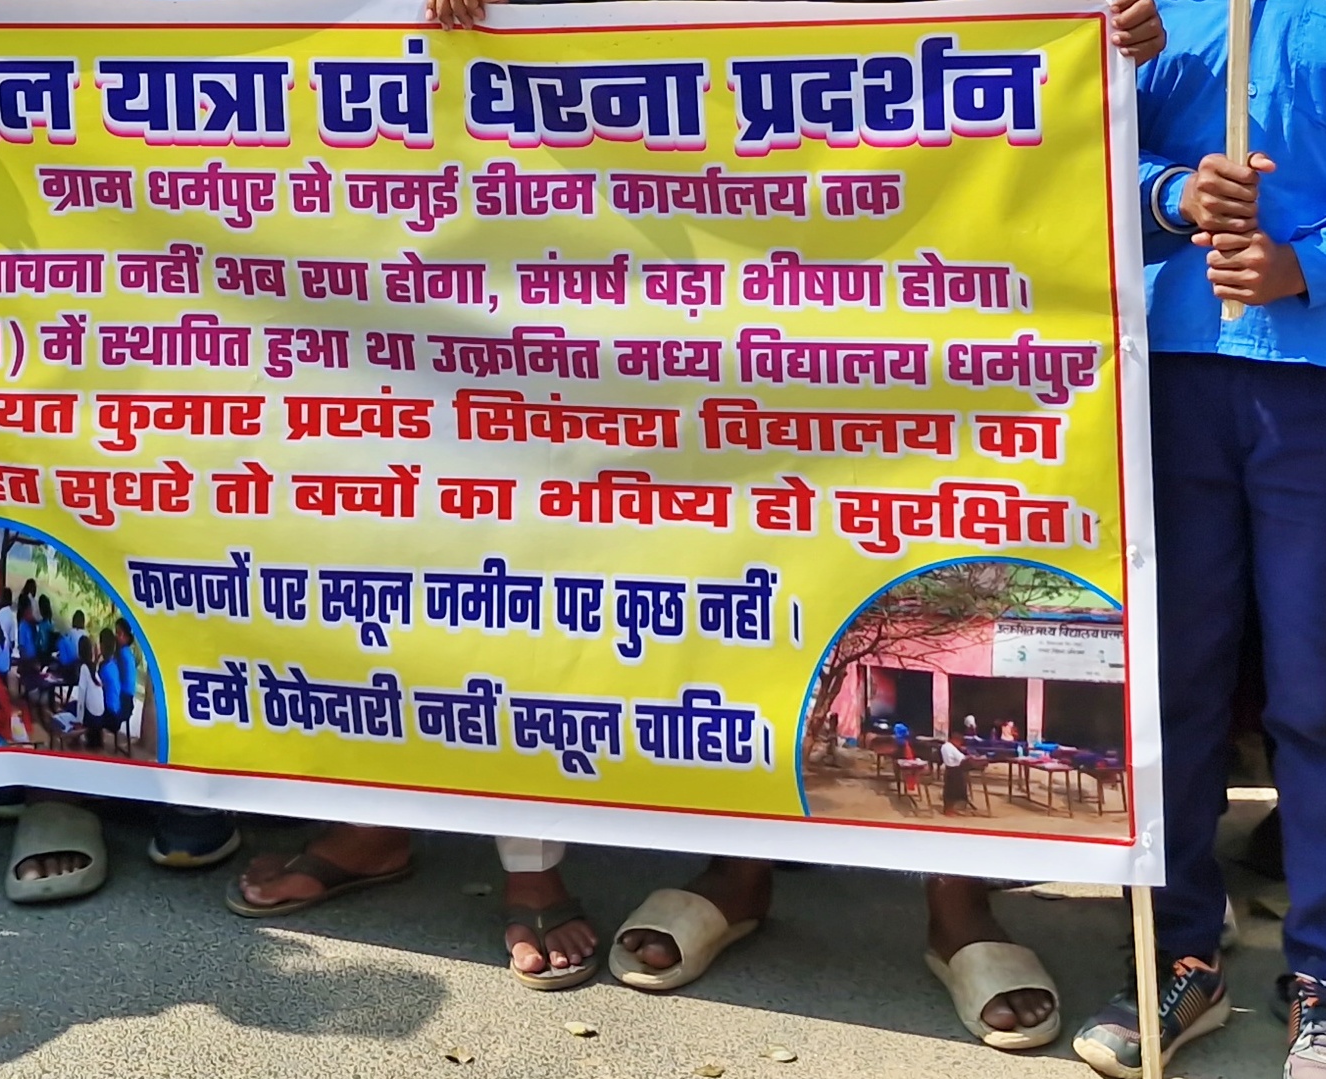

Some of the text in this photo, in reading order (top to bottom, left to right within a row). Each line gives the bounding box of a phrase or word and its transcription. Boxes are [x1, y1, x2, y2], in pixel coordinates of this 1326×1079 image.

[97, 60, 291, 141] यात्रा
[313, 39, 437, 142] एवं
[468, 56, 707, 144] धरना
[731, 36, 1044, 150] प्रदर्शन
[39, 162, 904, 231] ग्राम धर्मपुर से जमुई डीएम कार्यालय तक
[118, 245, 204, 295] नहीं
[217, 257, 286, 297] अब
[298, 261, 368, 302] रण
[518, 251, 629, 306] संघर्ष
[643, 264, 725, 317] बड़ा
[742, 251, 881, 306] भीषण
[41, 315, 88, 365] में
[100, 314, 251, 367] स्थापित
[264, 326, 349, 378] हुआ
[366, 332, 415, 371] था
[615, 339, 722, 382] मध्य
[738, 327, 929, 385] विद्यालय
[948, 334, 1099, 403] धर्मपुर
[97, 394, 266, 451] कुमार
[284, 385, 434, 441] प्रखंड
[452, 388, 680, 448] सिकंदरा
[699, 397, 955, 455] विद्यालय
[975, 415, 1062, 459] का
[56, 461, 193, 526] सुधरे
[212, 462, 274, 514] तो
[292, 465, 422, 518] बच्चों
[438, 478, 516, 520] का
[540, 469, 732, 527] भविष्य
[750, 476, 816, 532] हो
[127, 552, 252, 618] कागजों
[261, 566, 307, 620] पर
[319, 568, 413, 647] स्कूल
[424, 558, 542, 631] जमीन
[554, 576, 603, 633] पर
[615, 579, 686, 658] कुछ
[182, 662, 772, 774] हमें ठेकेदारी नहीं स्कूल चाहिए।
